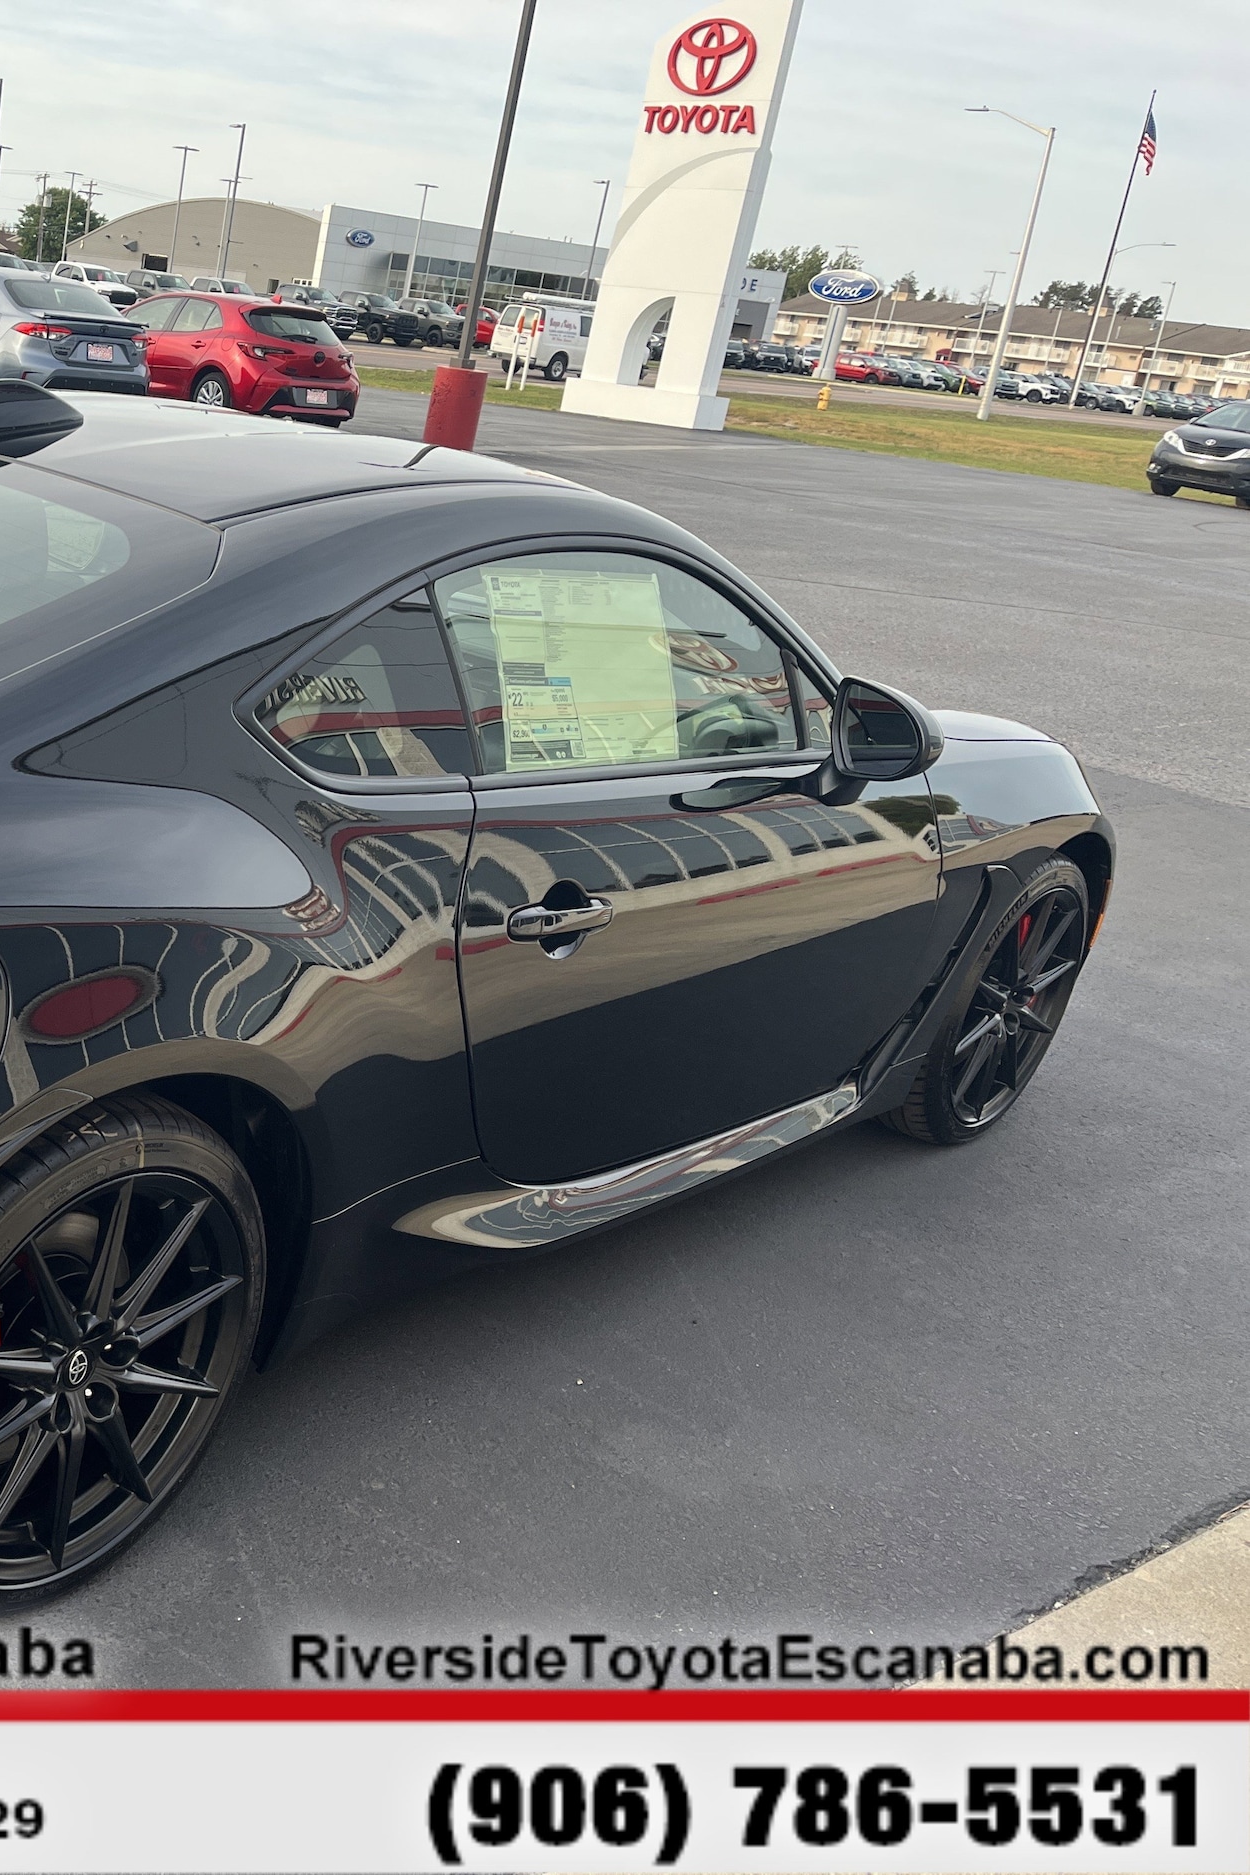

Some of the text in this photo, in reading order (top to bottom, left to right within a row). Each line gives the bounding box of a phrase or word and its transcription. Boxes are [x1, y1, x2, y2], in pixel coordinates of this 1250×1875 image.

[643, 104, 756, 135] TOYOTA
[822, 276, 865, 299] Ford
[500, 580, 522, 588] TOYOTA
[513, 692, 524, 707] 22
